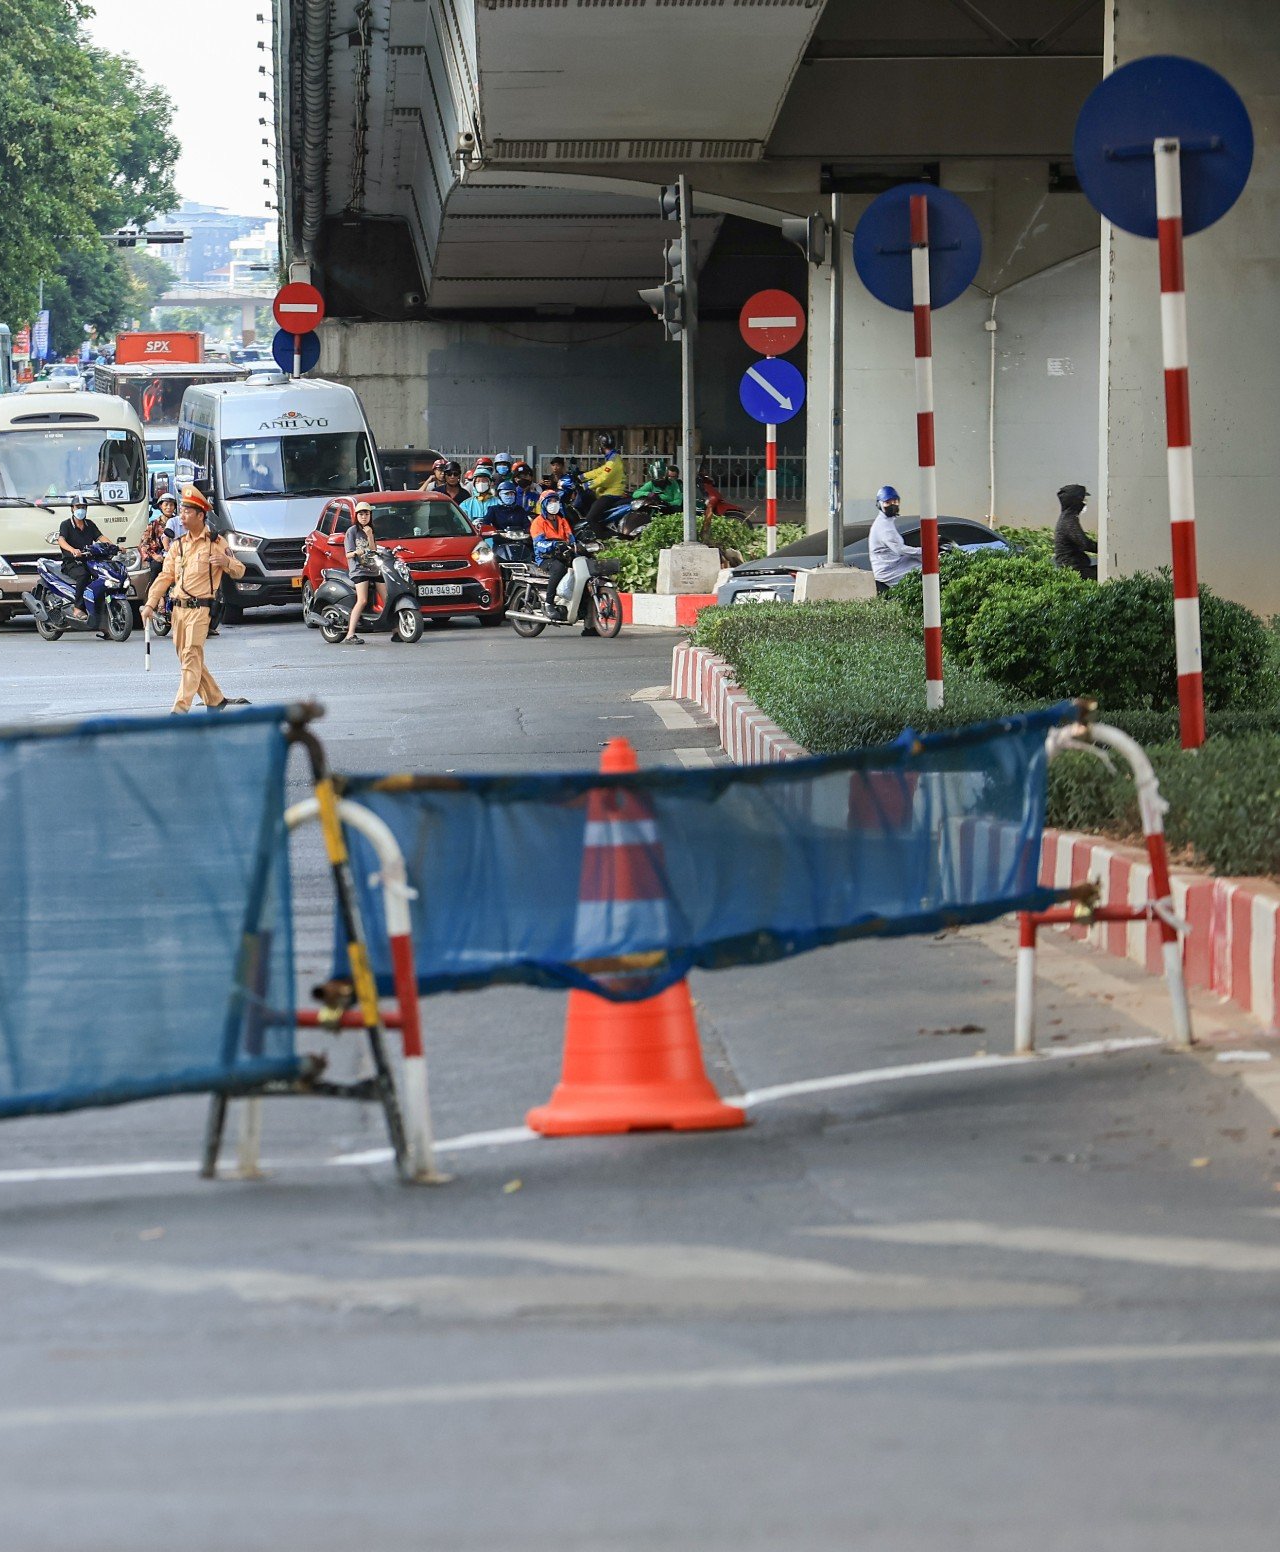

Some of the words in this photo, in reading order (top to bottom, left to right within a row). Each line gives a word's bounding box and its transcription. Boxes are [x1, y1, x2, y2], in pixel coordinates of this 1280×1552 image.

[146, 340, 170, 351] SPX
[258, 420, 296, 430] ANH
[108, 489, 124, 499] 02
[420, 586, 461, 596] 30A-949.50
